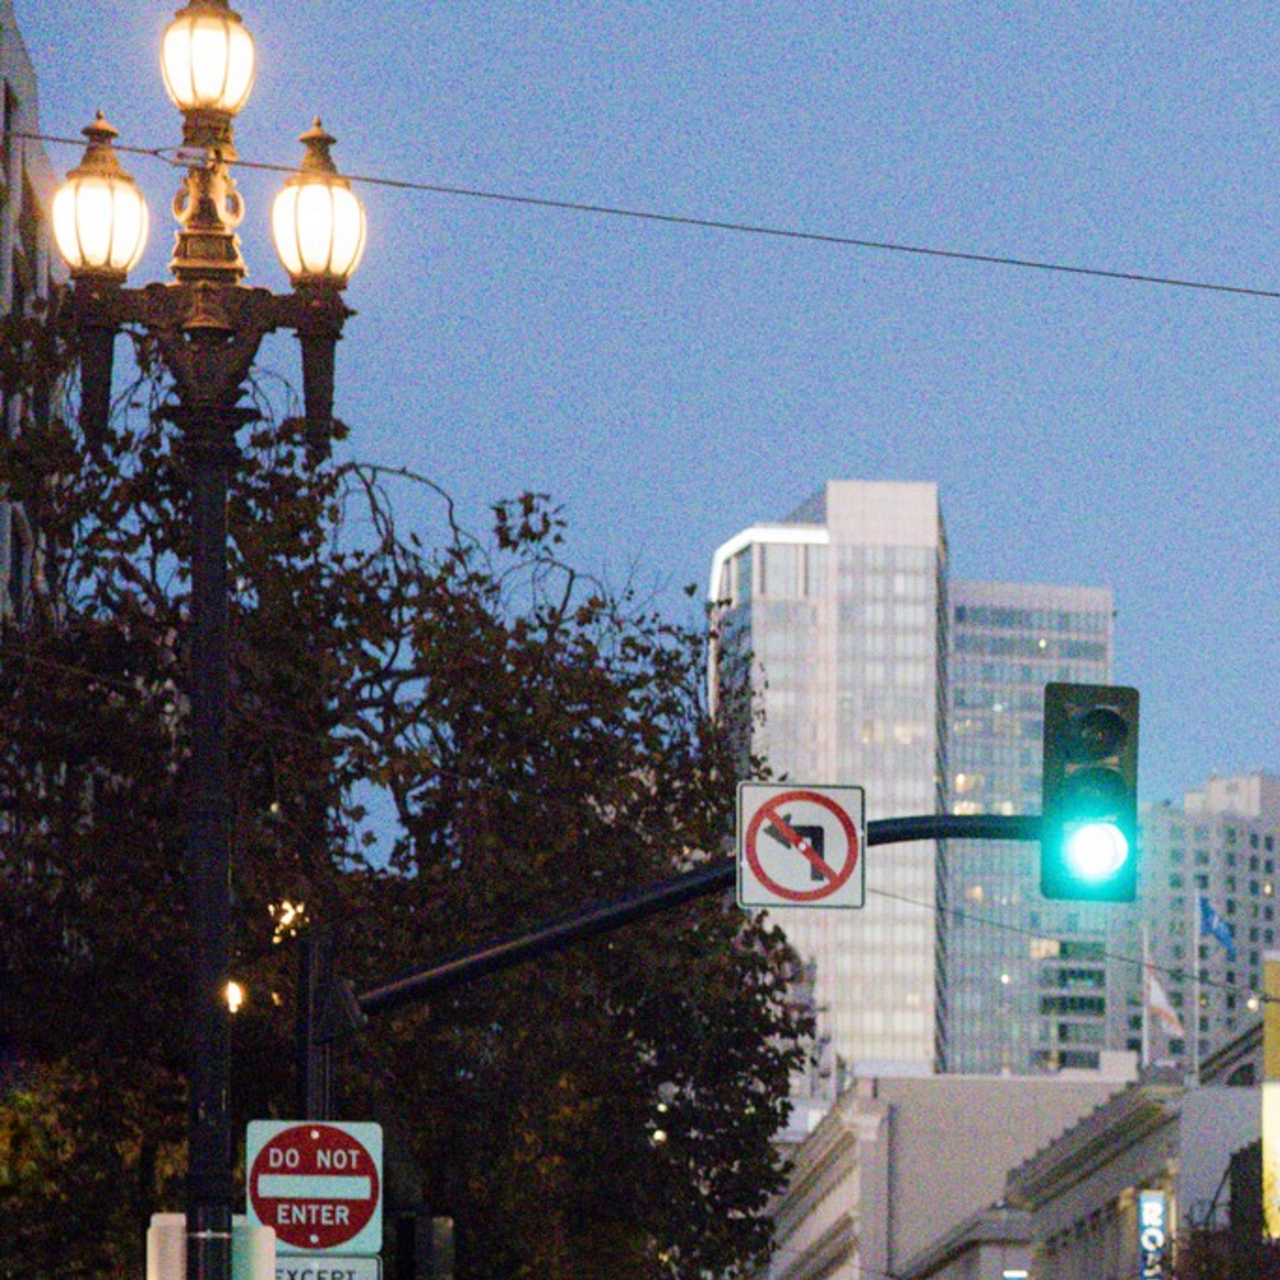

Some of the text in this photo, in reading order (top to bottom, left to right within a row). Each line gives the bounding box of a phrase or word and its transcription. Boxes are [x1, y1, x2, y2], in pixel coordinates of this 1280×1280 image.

[268, 1148, 360, 1170] DO NOT
[276, 1204, 350, 1226] ENTER
